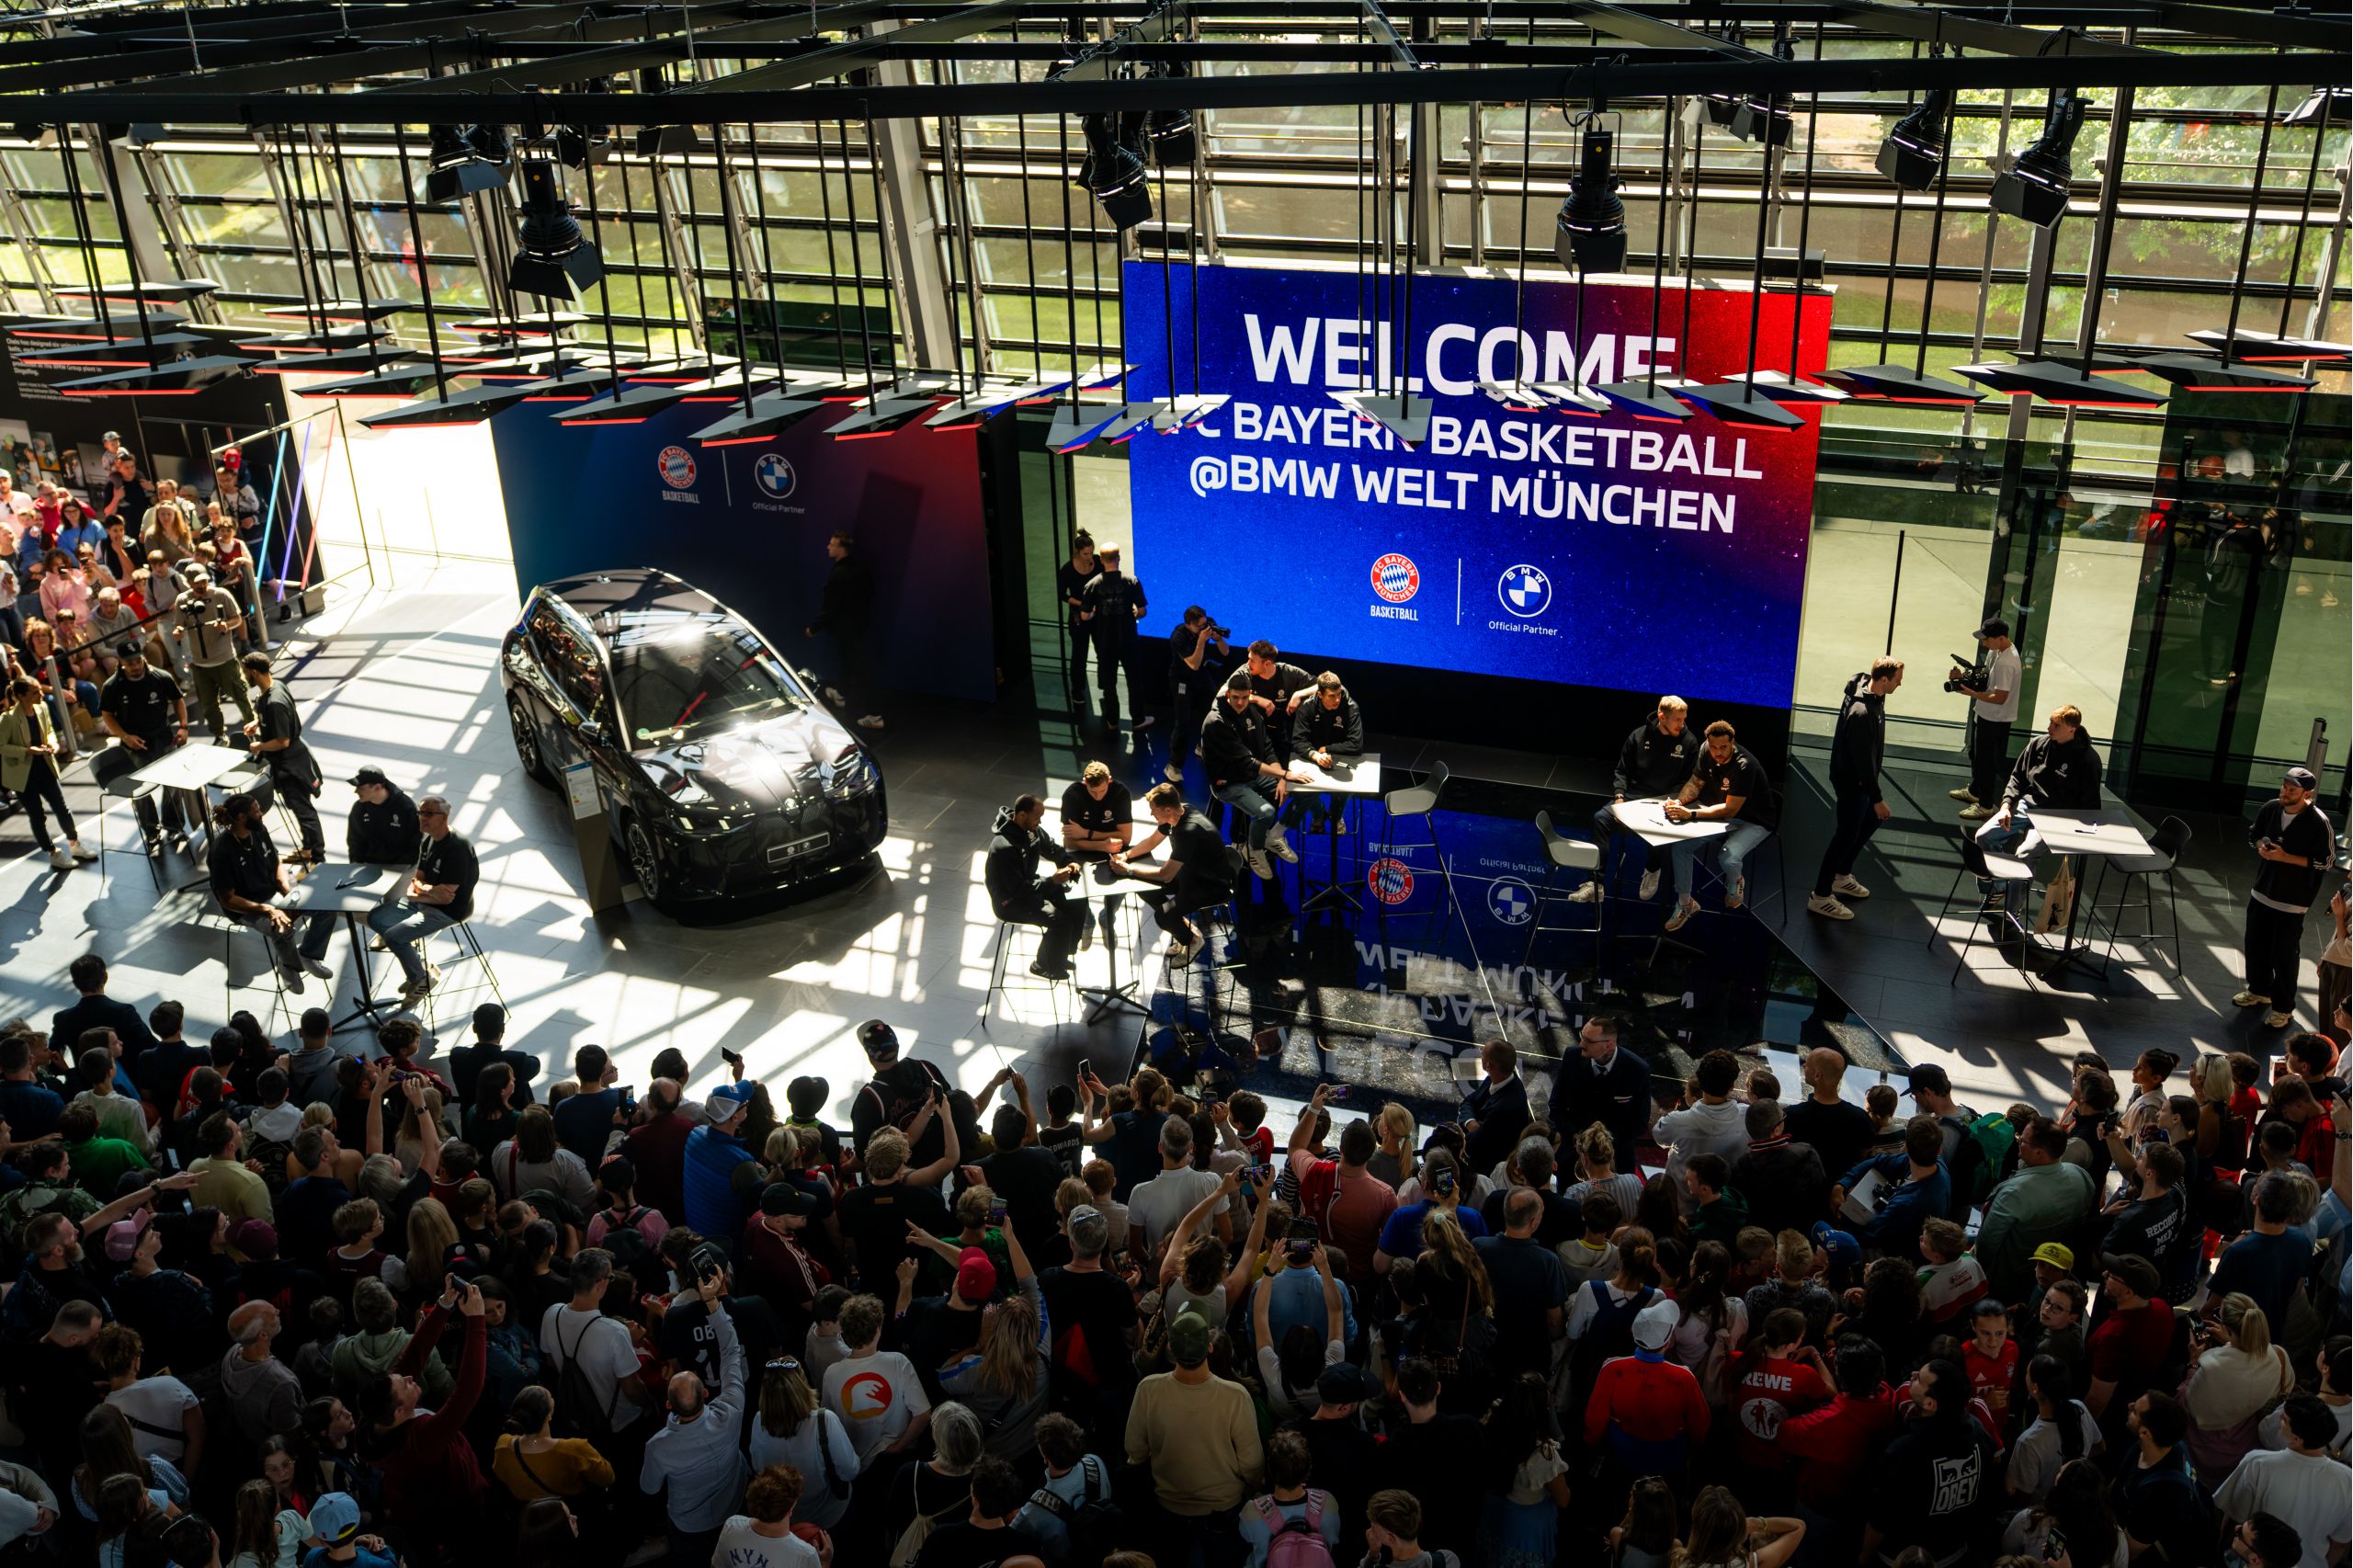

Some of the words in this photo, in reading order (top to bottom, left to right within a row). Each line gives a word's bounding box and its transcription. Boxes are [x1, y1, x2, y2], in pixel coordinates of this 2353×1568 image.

[1245, 313, 1677, 404] WELCOME
[1431, 415, 1762, 480] BASKETBALL
[759, 456, 789, 470] BMW
[662, 490, 699, 504] BASKETBALL
[1190, 454, 1340, 499] @BMW
[1352, 463, 1478, 510] WELT
[1491, 470, 1736, 534] MÜNCHEN
[753, 502, 777, 512] Official
[779, 504, 805, 515] Partner
[1384, 555, 1416, 576] BAYERN
[1506, 567, 1545, 584] BMW
[1370, 605, 1418, 621] BASKETBALL
[1488, 620, 1521, 632] Official
[1523, 624, 1558, 636] Partner
[1936, 1473, 1978, 1511] OBEY
